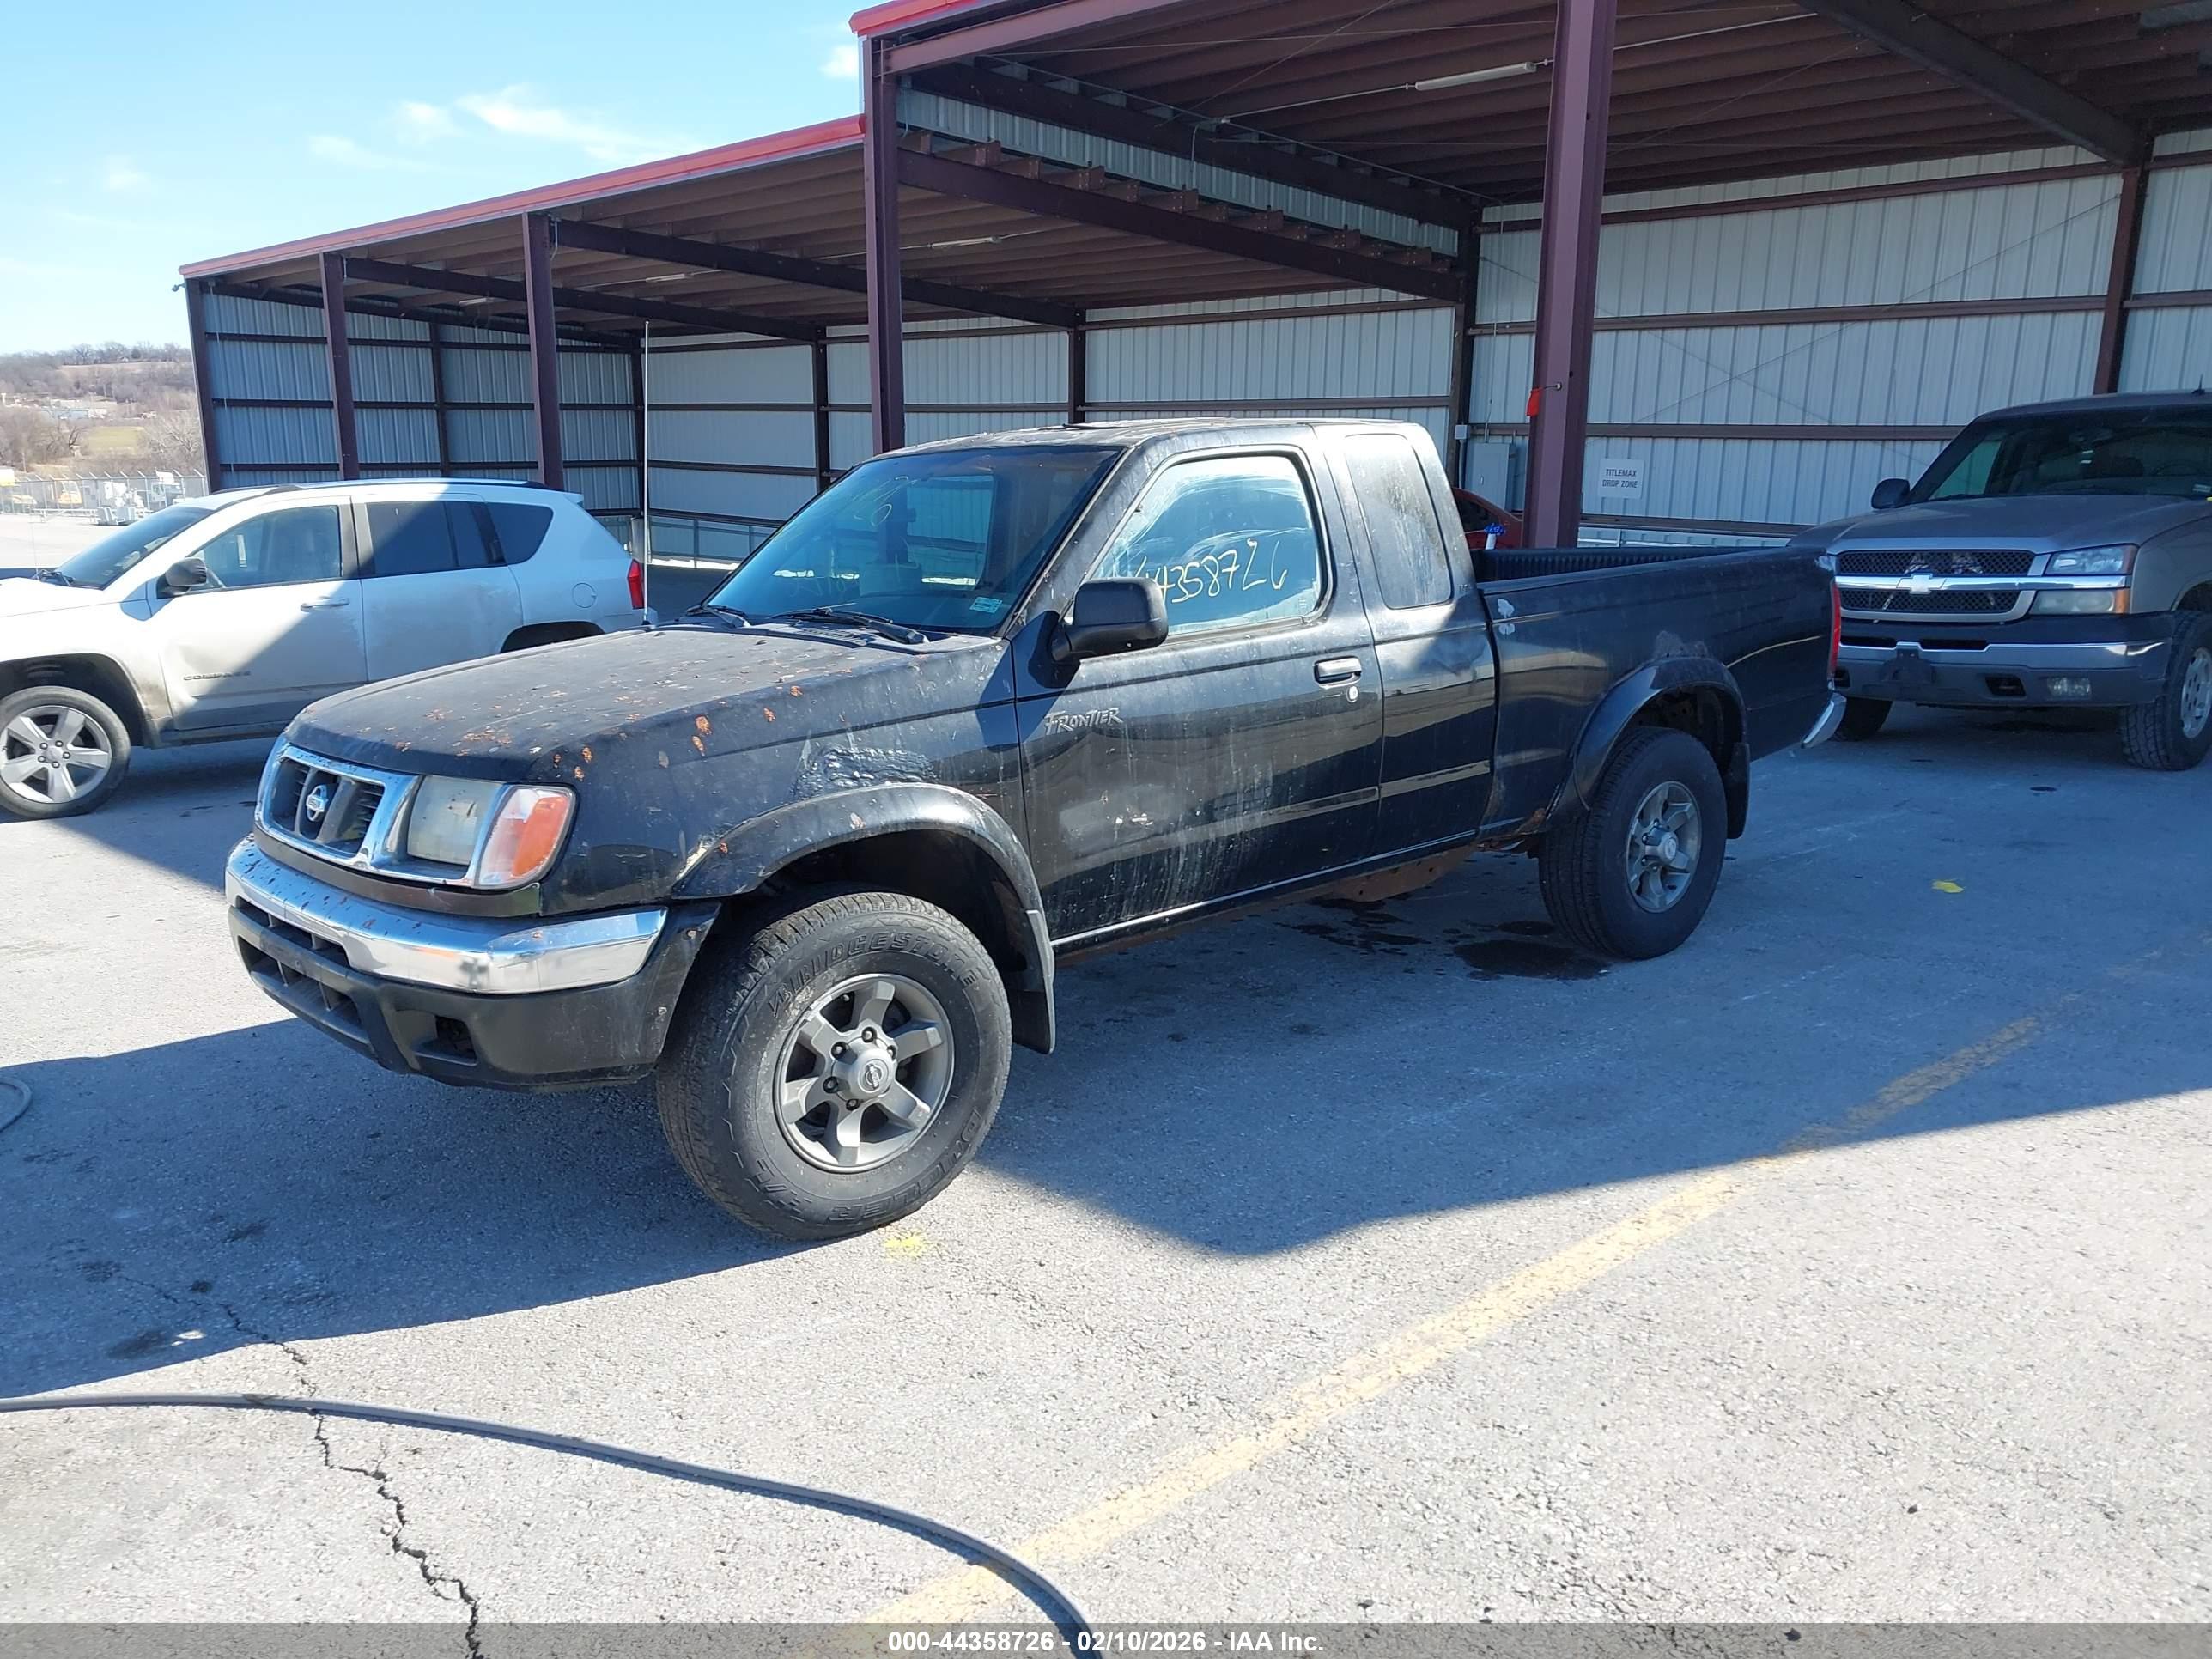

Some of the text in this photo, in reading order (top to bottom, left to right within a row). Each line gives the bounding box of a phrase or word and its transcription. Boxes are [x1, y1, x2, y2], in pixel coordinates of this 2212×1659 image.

[1606, 468, 1638, 477] TITLEMAX
[1044, 707, 1125, 736] FRONTIER
[778, 932, 979, 1001] BRIDGESTONE
